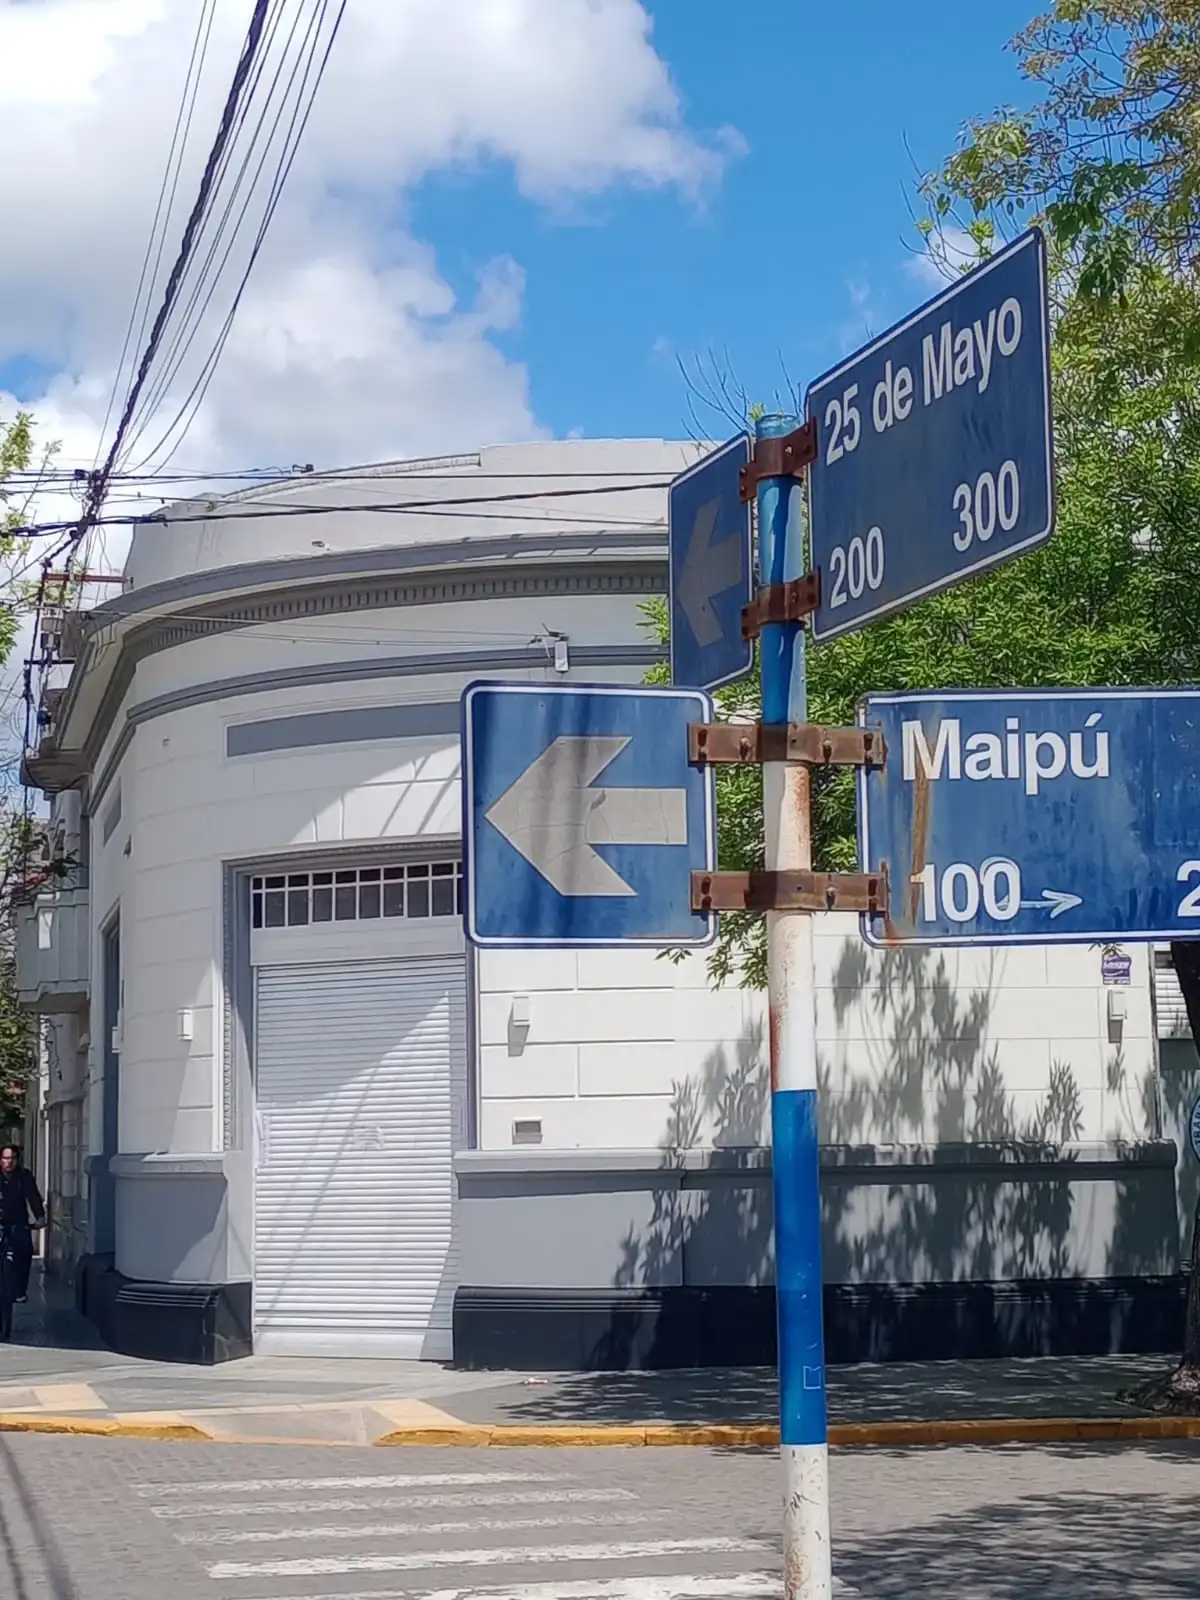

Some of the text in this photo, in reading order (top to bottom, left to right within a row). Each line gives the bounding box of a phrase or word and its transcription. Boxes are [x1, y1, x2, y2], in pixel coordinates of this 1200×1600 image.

[825, 297, 1022, 466] 25 de Mayo
[829, 460, 1020, 610] 200 300
[902, 713, 1109, 795] Maipú
[910, 861, 1021, 922] 100
